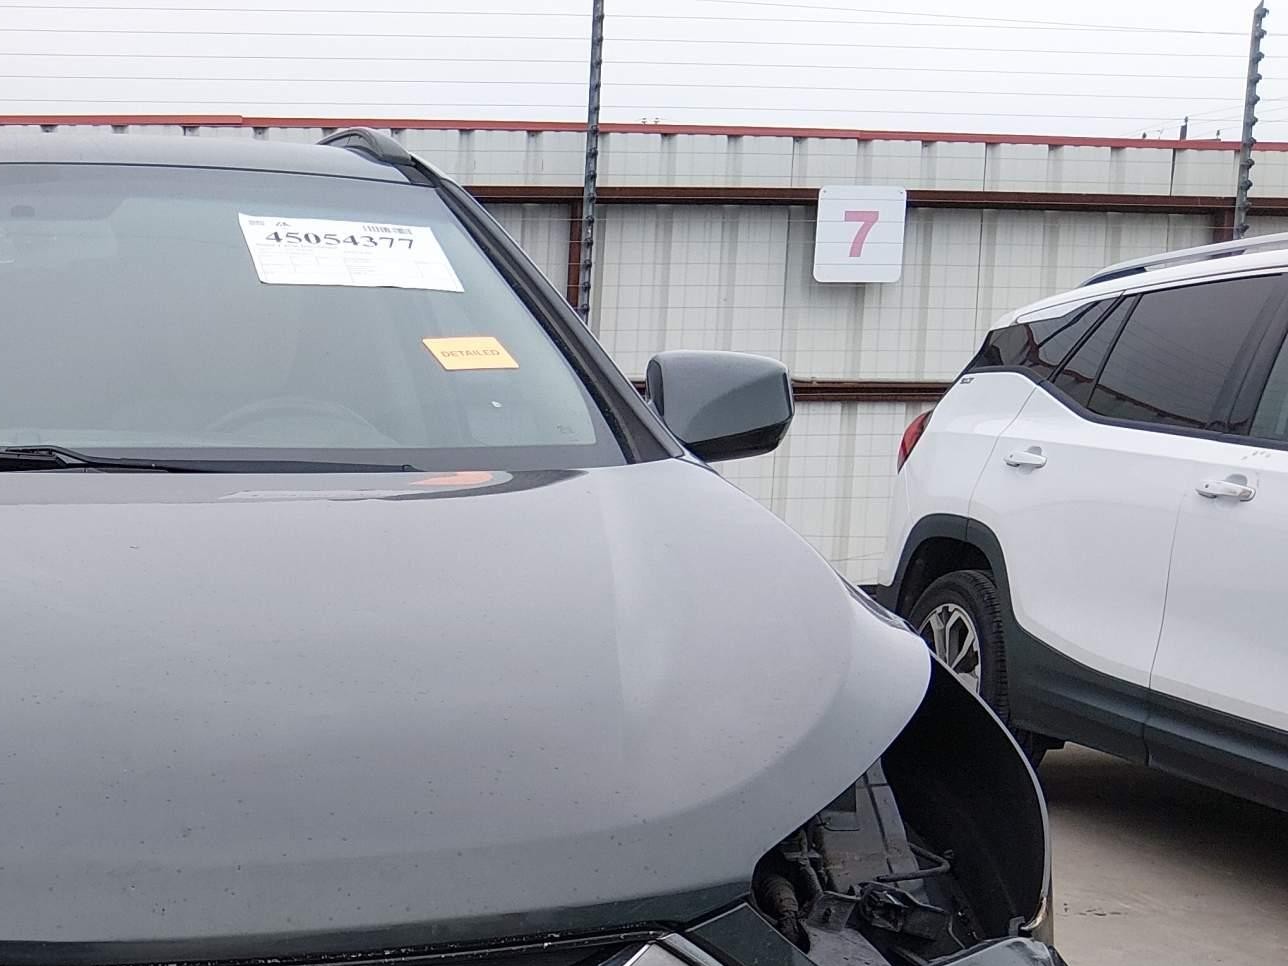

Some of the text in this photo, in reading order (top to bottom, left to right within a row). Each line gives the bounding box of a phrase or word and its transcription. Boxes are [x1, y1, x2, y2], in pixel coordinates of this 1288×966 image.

[265, 231, 414, 250] 45054377
[843, 210, 880, 258] 7
[440, 349, 500, 358] DETAILED
